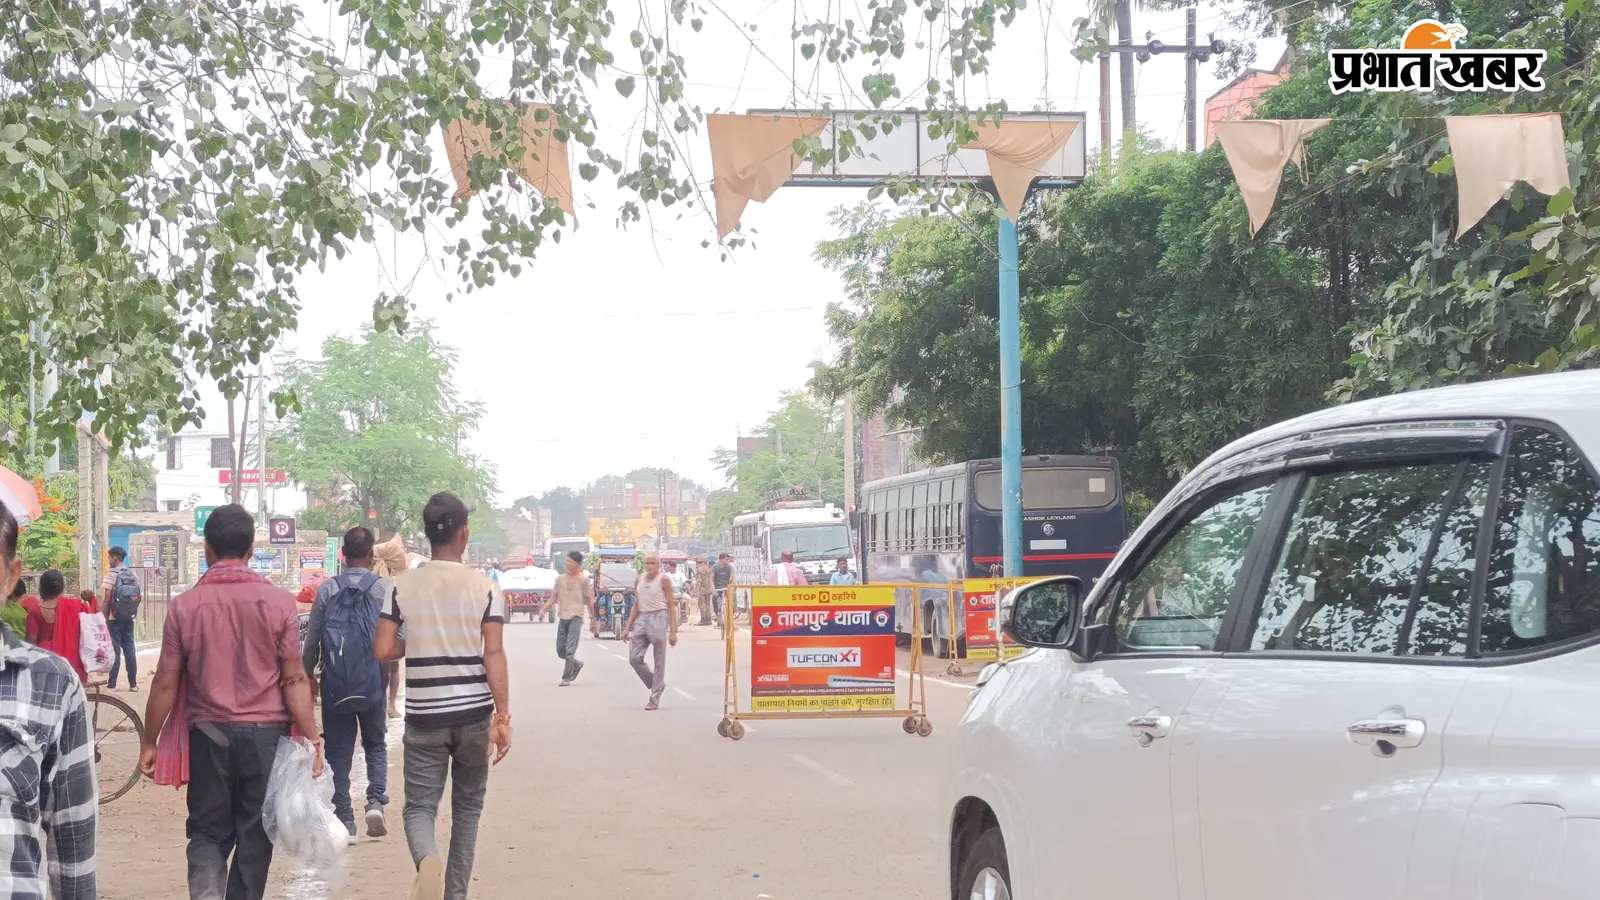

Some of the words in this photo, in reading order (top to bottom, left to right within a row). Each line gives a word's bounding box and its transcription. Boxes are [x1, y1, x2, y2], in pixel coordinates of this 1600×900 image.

[791, 593, 817, 601] STOP
[831, 591, 856, 601] ठहरिये
[777, 611, 830, 630] तारापुर
[834, 610, 871, 626] थाना
[789, 653, 838, 663] TUFCON
[839, 649, 859, 662] XT
[820, 698, 839, 708] पालन
[855, 697, 879, 708] सुरक्षित
